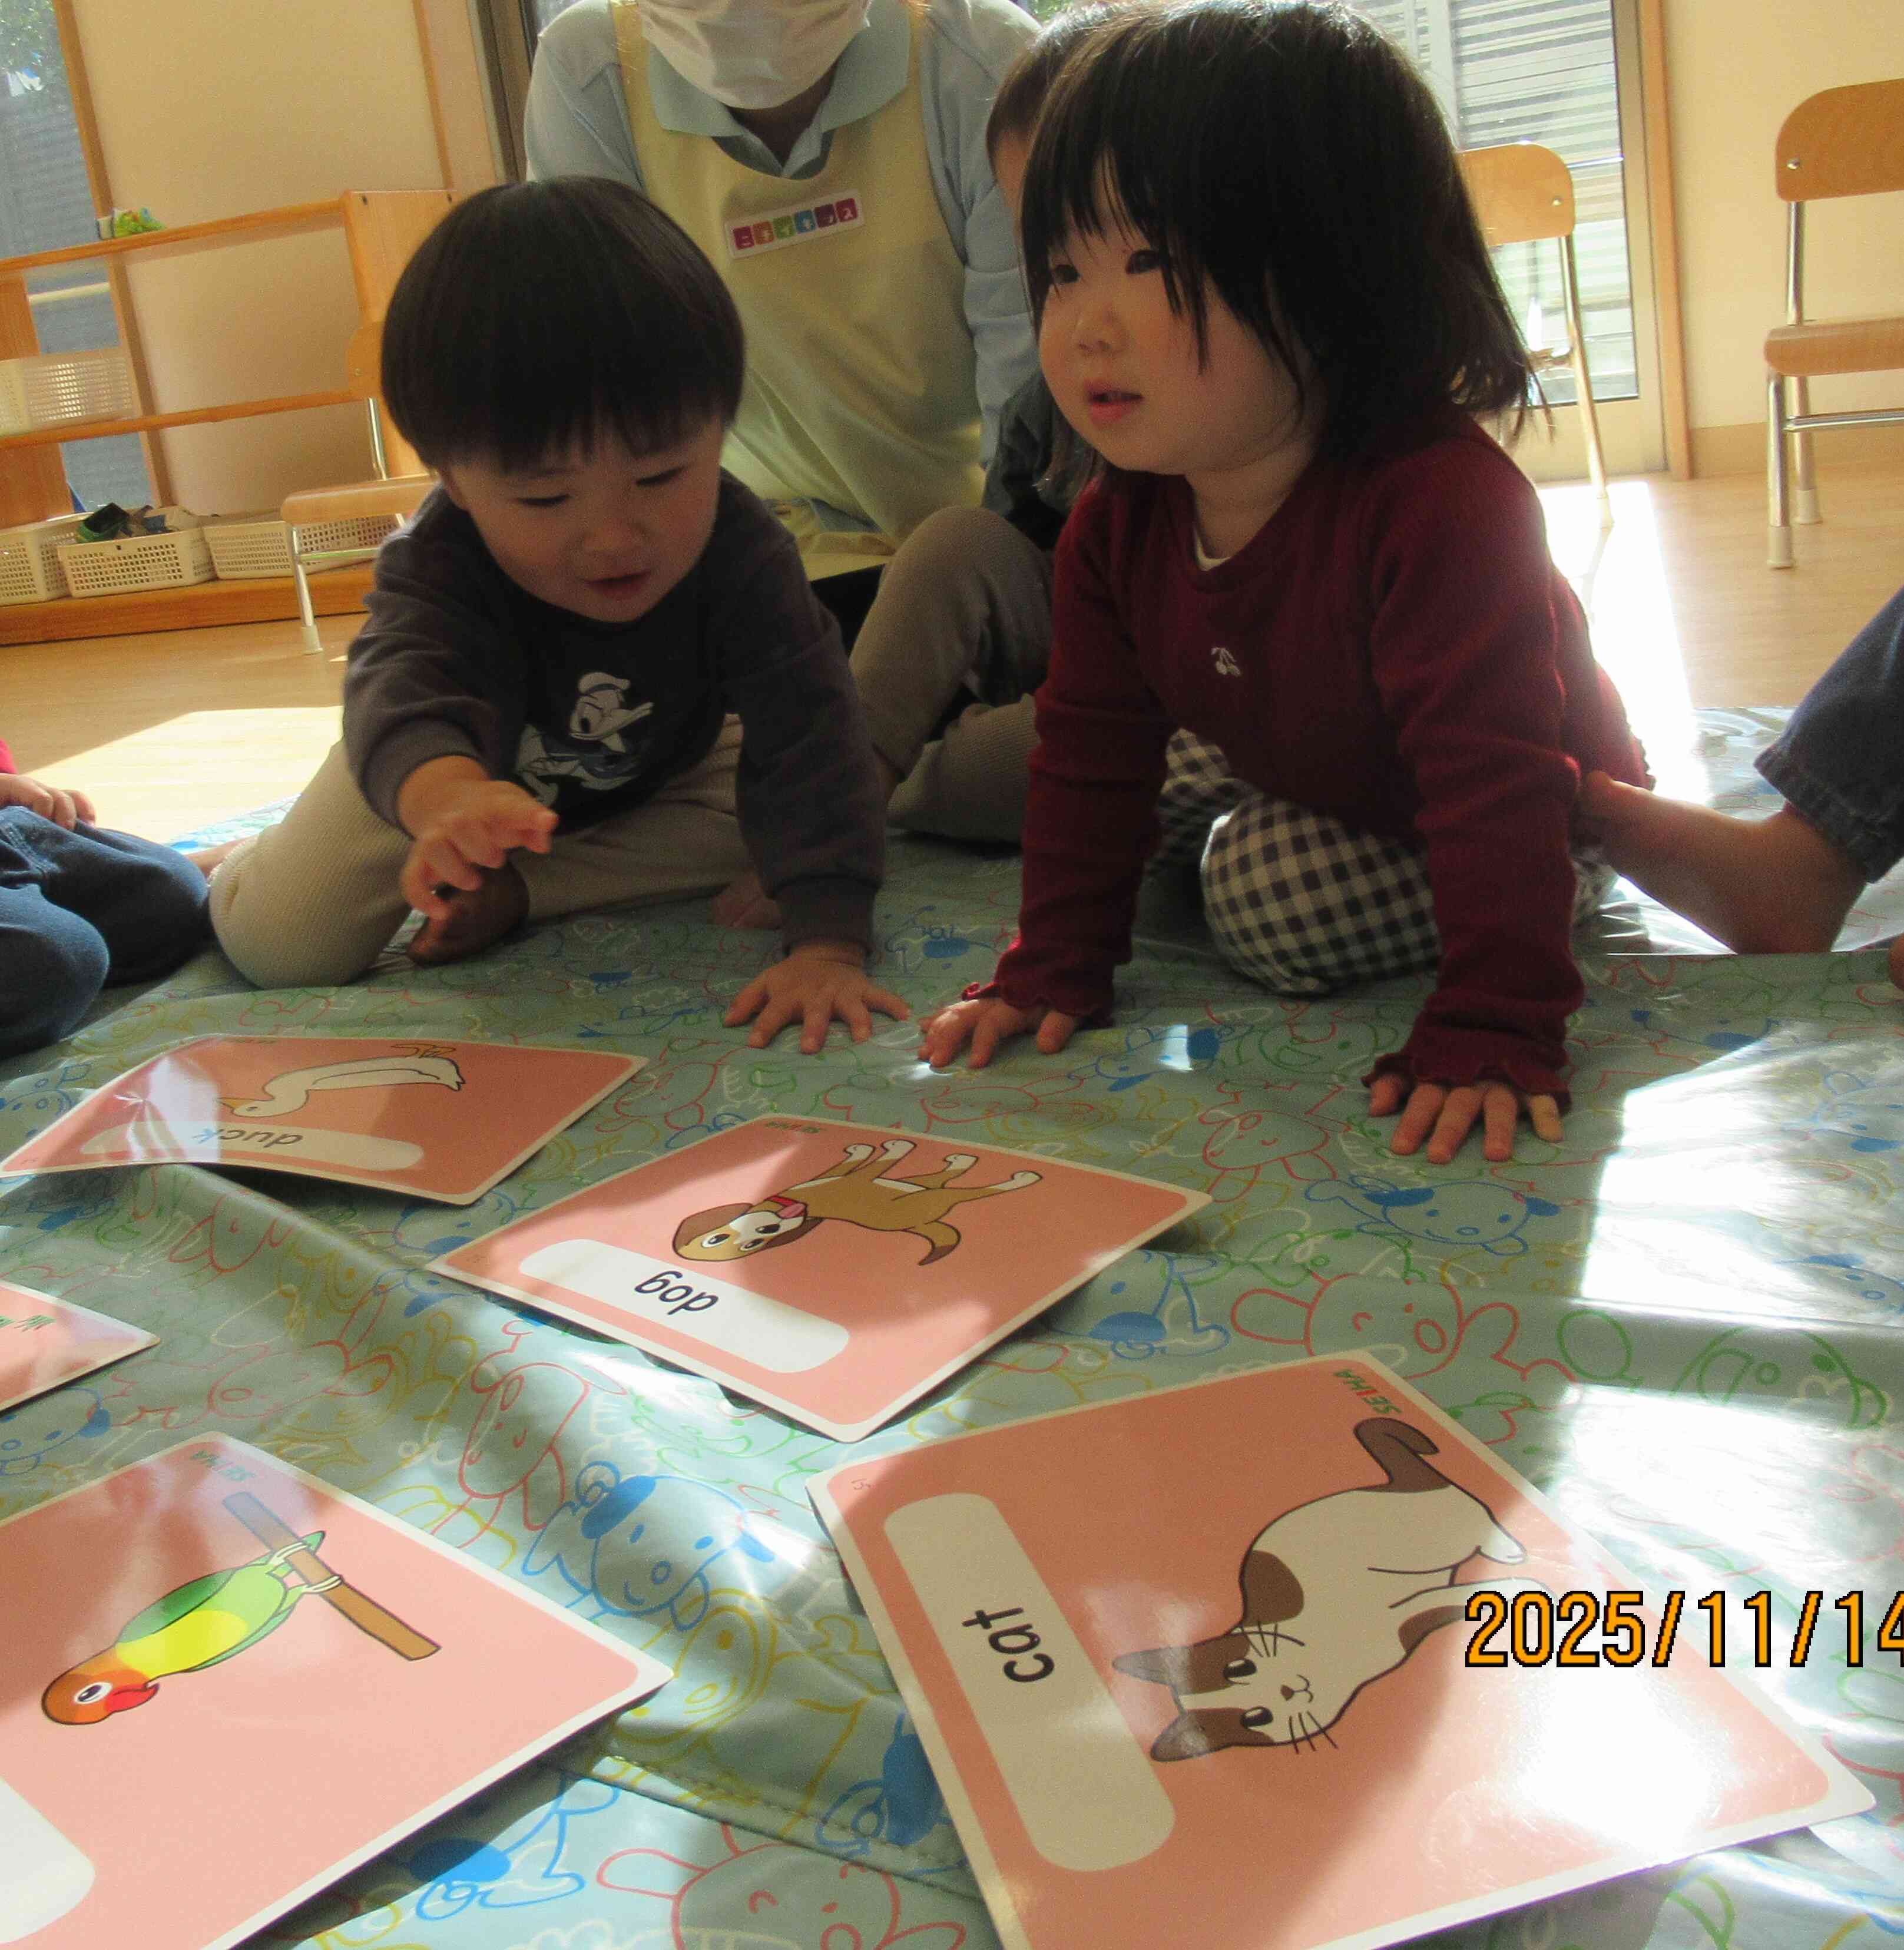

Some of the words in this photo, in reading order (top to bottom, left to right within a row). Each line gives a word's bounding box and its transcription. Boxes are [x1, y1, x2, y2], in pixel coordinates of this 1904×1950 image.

[191, 1128, 303, 1148] duck
[634, 1270, 719, 1316] dog
[1333, 1369, 1403, 1415] SEIHA
[961, 1607, 1055, 1683] cat
